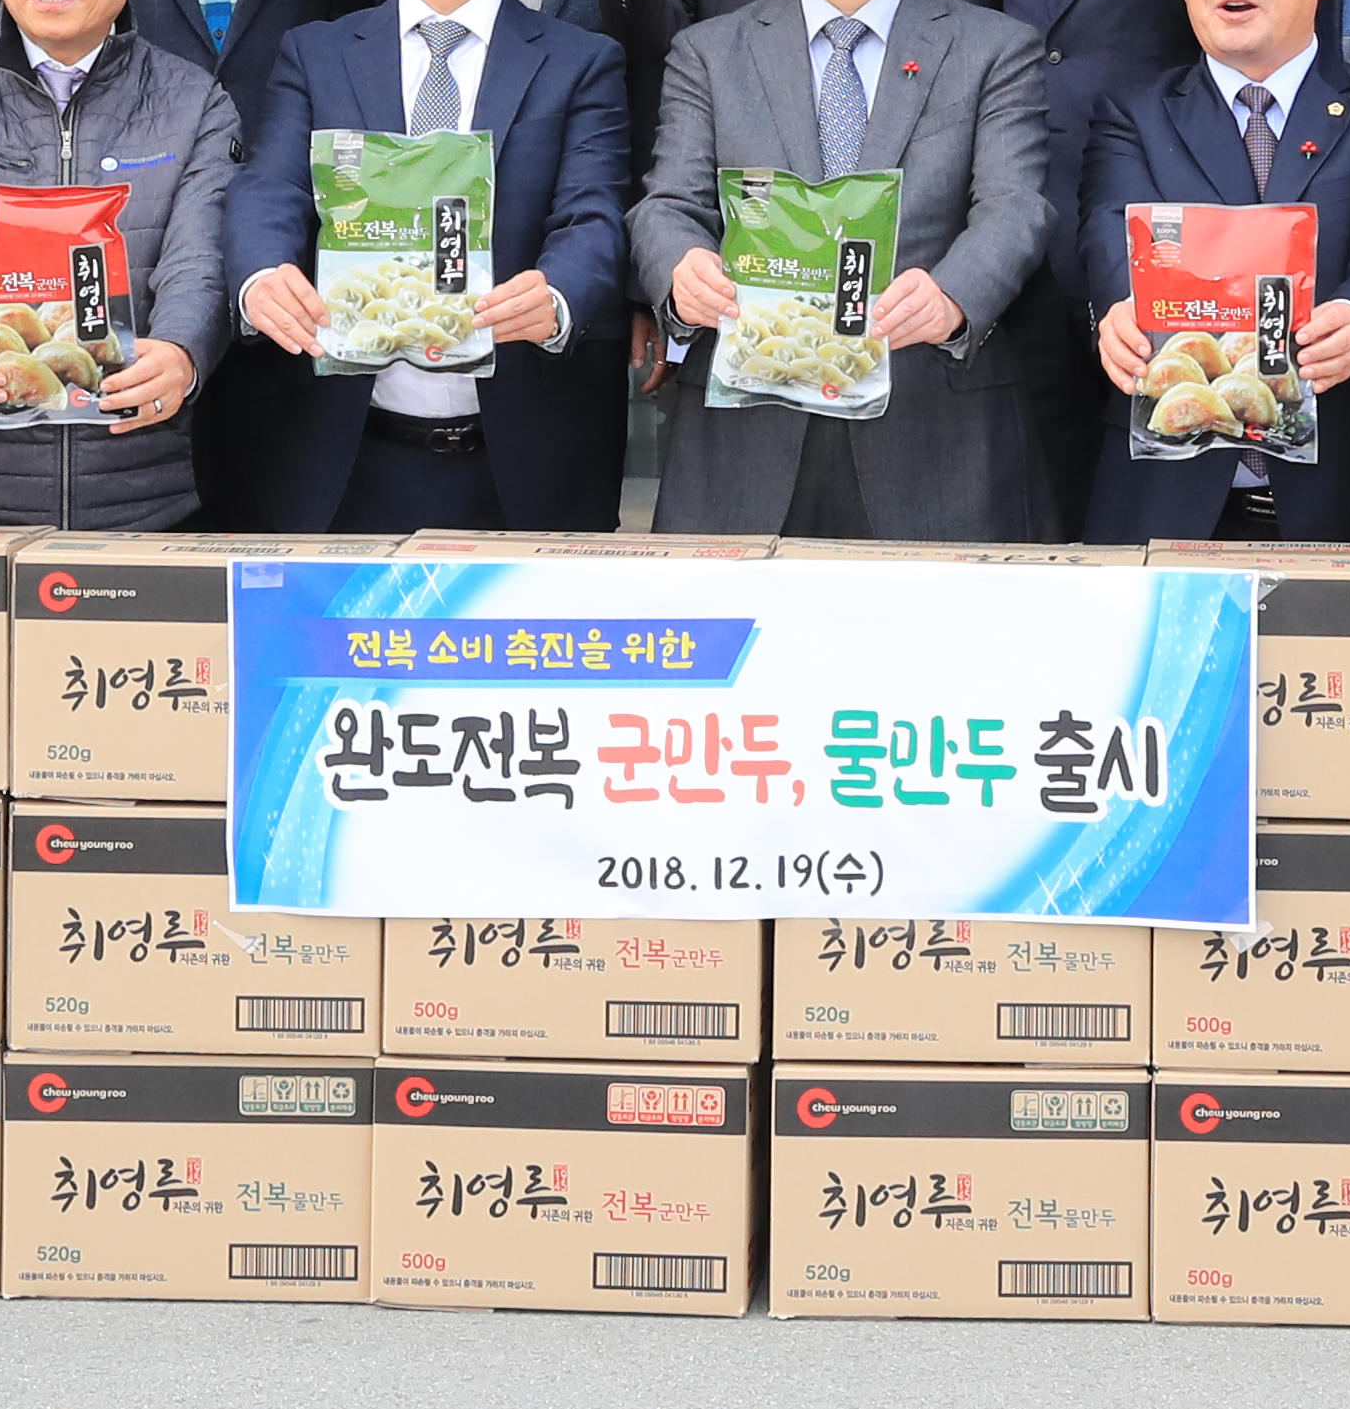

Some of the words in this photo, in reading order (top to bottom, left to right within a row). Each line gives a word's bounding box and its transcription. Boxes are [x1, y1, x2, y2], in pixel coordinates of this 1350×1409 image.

[440, 205, 463, 284] 취영루
[736, 255, 834, 281] 완도전복물만두
[78, 254, 104, 332] 취영루
[842, 249, 865, 327] 취영루
[1152, 299, 1254, 321] 완도전복군만두
[1263, 284, 1285, 366] 취영루
[348, 629, 417, 670] 전복
[428, 631, 493, 663] 소비
[506, 629, 612, 670] 촉진을
[622, 629, 696, 669] 위한
[62, 656, 207, 712] 취영루
[48, 745, 90, 762] 520g
[324, 708, 581, 809] 완도전복
[598, 713, 805, 806] 군만두,
[824, 710, 1017, 808] 물만두
[1035, 708, 1160, 814] 출시
[598, 857, 696, 890] 2018.
[715, 857, 761, 890] 12.
[778, 851, 883, 896] 19(수)
[60, 908, 207, 964] 취영루
[247, 934, 349, 965] 전복물만두
[427, 919, 580, 972] 취영루
[616, 938, 723, 969] 전복군만두
[818, 919, 970, 972] 취영루
[1008, 941, 1115, 972] 전복물만두
[46, 997, 88, 1014] 520g
[415, 1003, 457, 1020] 500g
[1187, 1017, 1231, 1034] 500g
[51, 1157, 200, 1212] 취영루
[237, 1181, 343, 1212] 전복물만두
[416, 1161, 569, 1221] 취영루
[820, 1172, 973, 1229] 취영루
[603, 1191, 710, 1222] 전복군만두
[1008, 1198, 1115, 1229] 전복물만두
[806, 1265, 850, 1282] 520g
[1188, 1270, 1232, 1288] 500g
